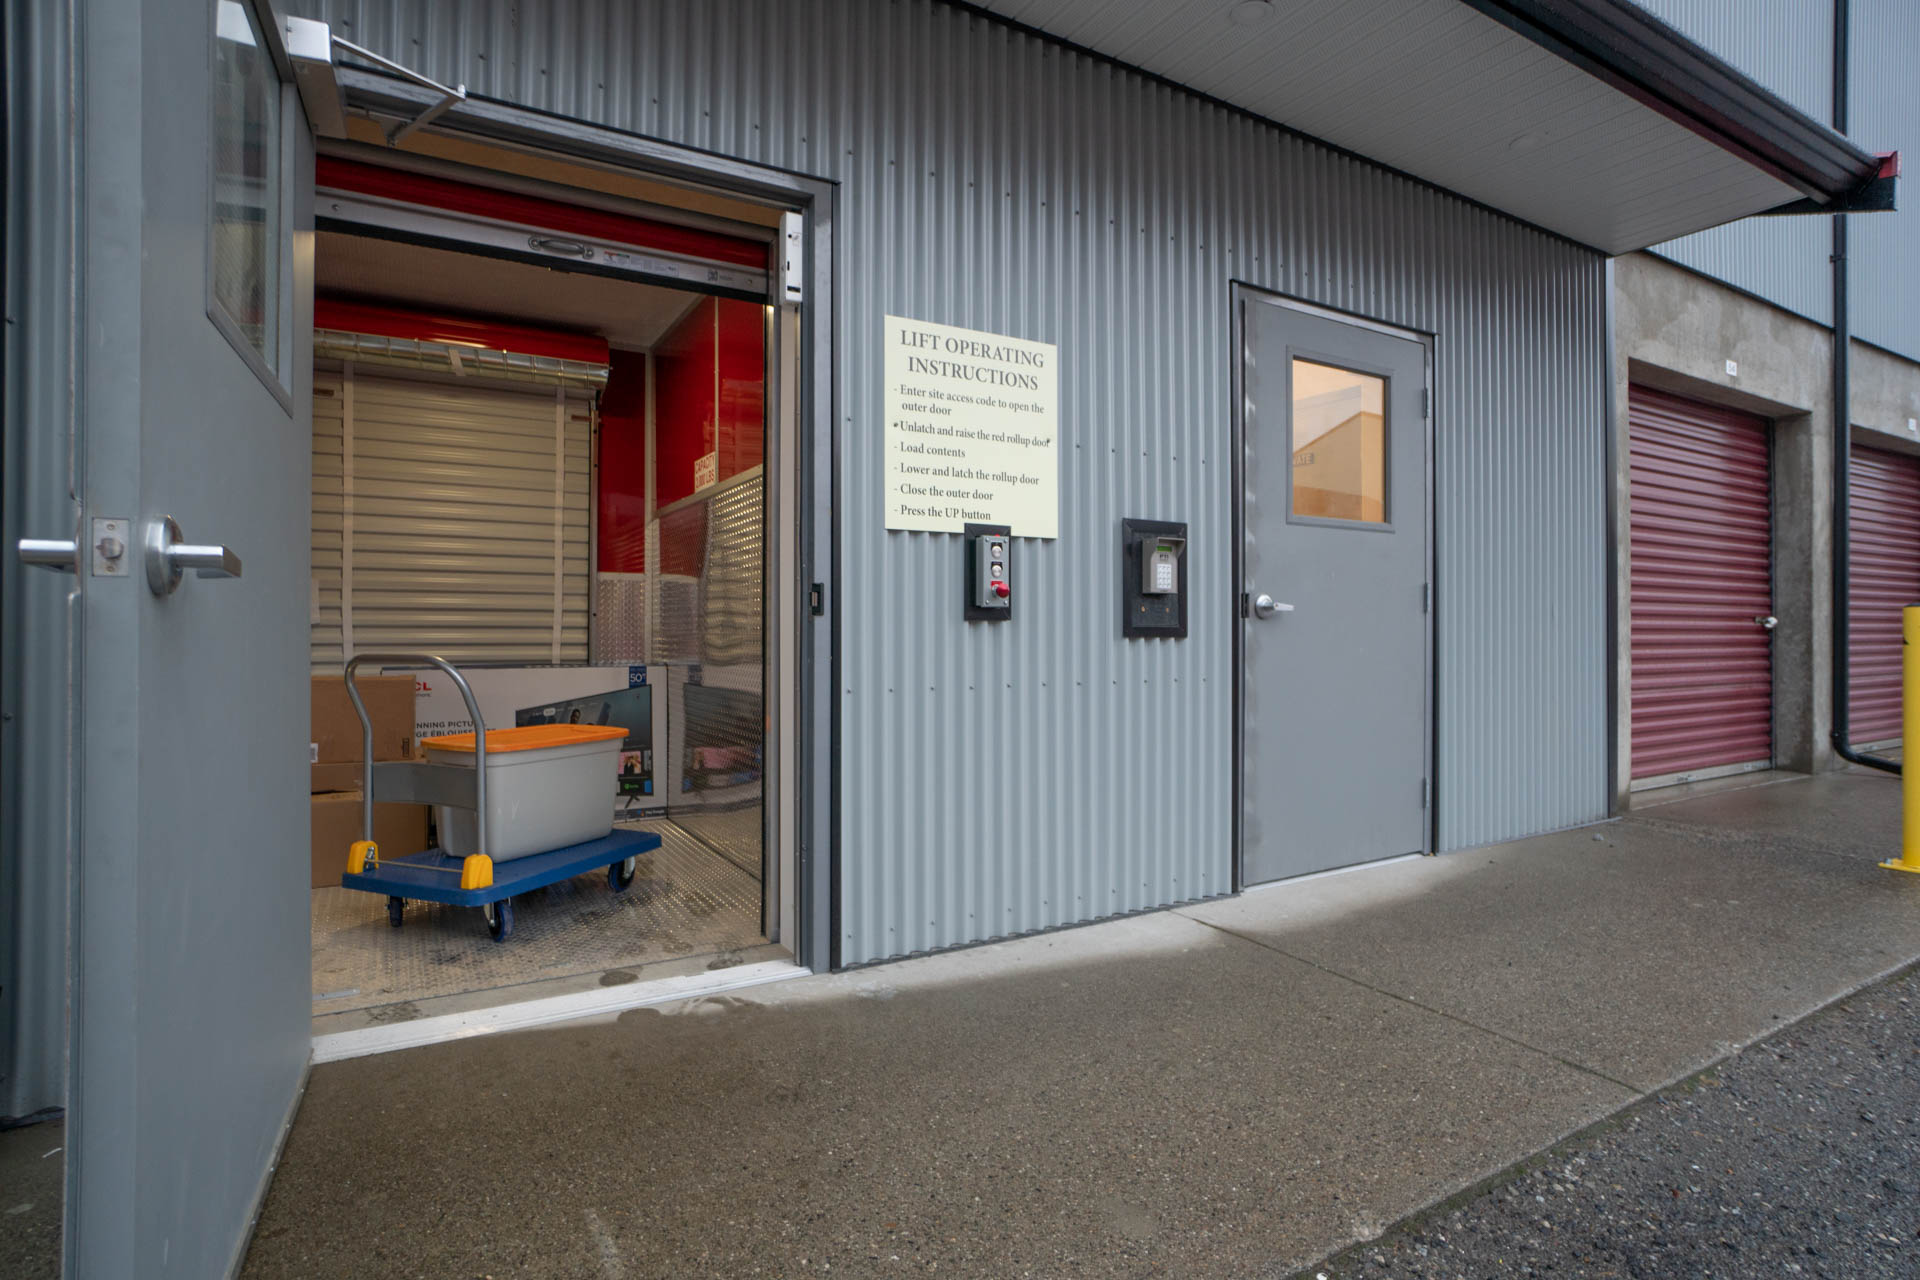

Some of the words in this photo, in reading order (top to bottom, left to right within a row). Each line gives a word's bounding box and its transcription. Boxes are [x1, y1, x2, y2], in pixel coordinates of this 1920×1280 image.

[900, 329, 941, 350] LIFT
[945, 337, 1044, 368] OPERATING
[908, 356, 1038, 391] INSTRUCTIONS
[900, 384, 926, 398] Enter
[928, 388, 944, 400] site
[946, 394, 973, 404] access
[976, 396, 996, 407] code
[998, 399, 1007, 408] to
[1009, 402, 1029, 414] open
[1031, 401, 1044, 414] the
[901, 402, 928, 413] outer
[929, 402, 952, 416] door
[900, 421, 935, 435] Unlatch
[937, 426, 953, 437] and
[955, 429, 975, 439] raise
[977, 430, 990, 440] the
[992, 431, 1005, 442] red
[1007, 432, 1031, 448] rollup
[1032, 436, 1049, 448] door
[900, 441, 924, 454] Load
[926, 445, 965, 458] contents
[900, 462, 930, 475] Lower
[932, 466, 950, 477] and
[952, 467, 974, 479] latch
[976, 469, 990, 481] the
[992, 470, 1018, 486] rollup
[1019, 473, 1040, 485] door
[900, 483, 927, 496] Close
[929, 486, 944, 497] the
[946, 489, 970, 499] outer
[972, 489, 994, 501] door
[900, 504, 925, 517] Press
[928, 506, 942, 517] the
[945, 507, 959, 518] UP
[961, 507, 991, 520] button
